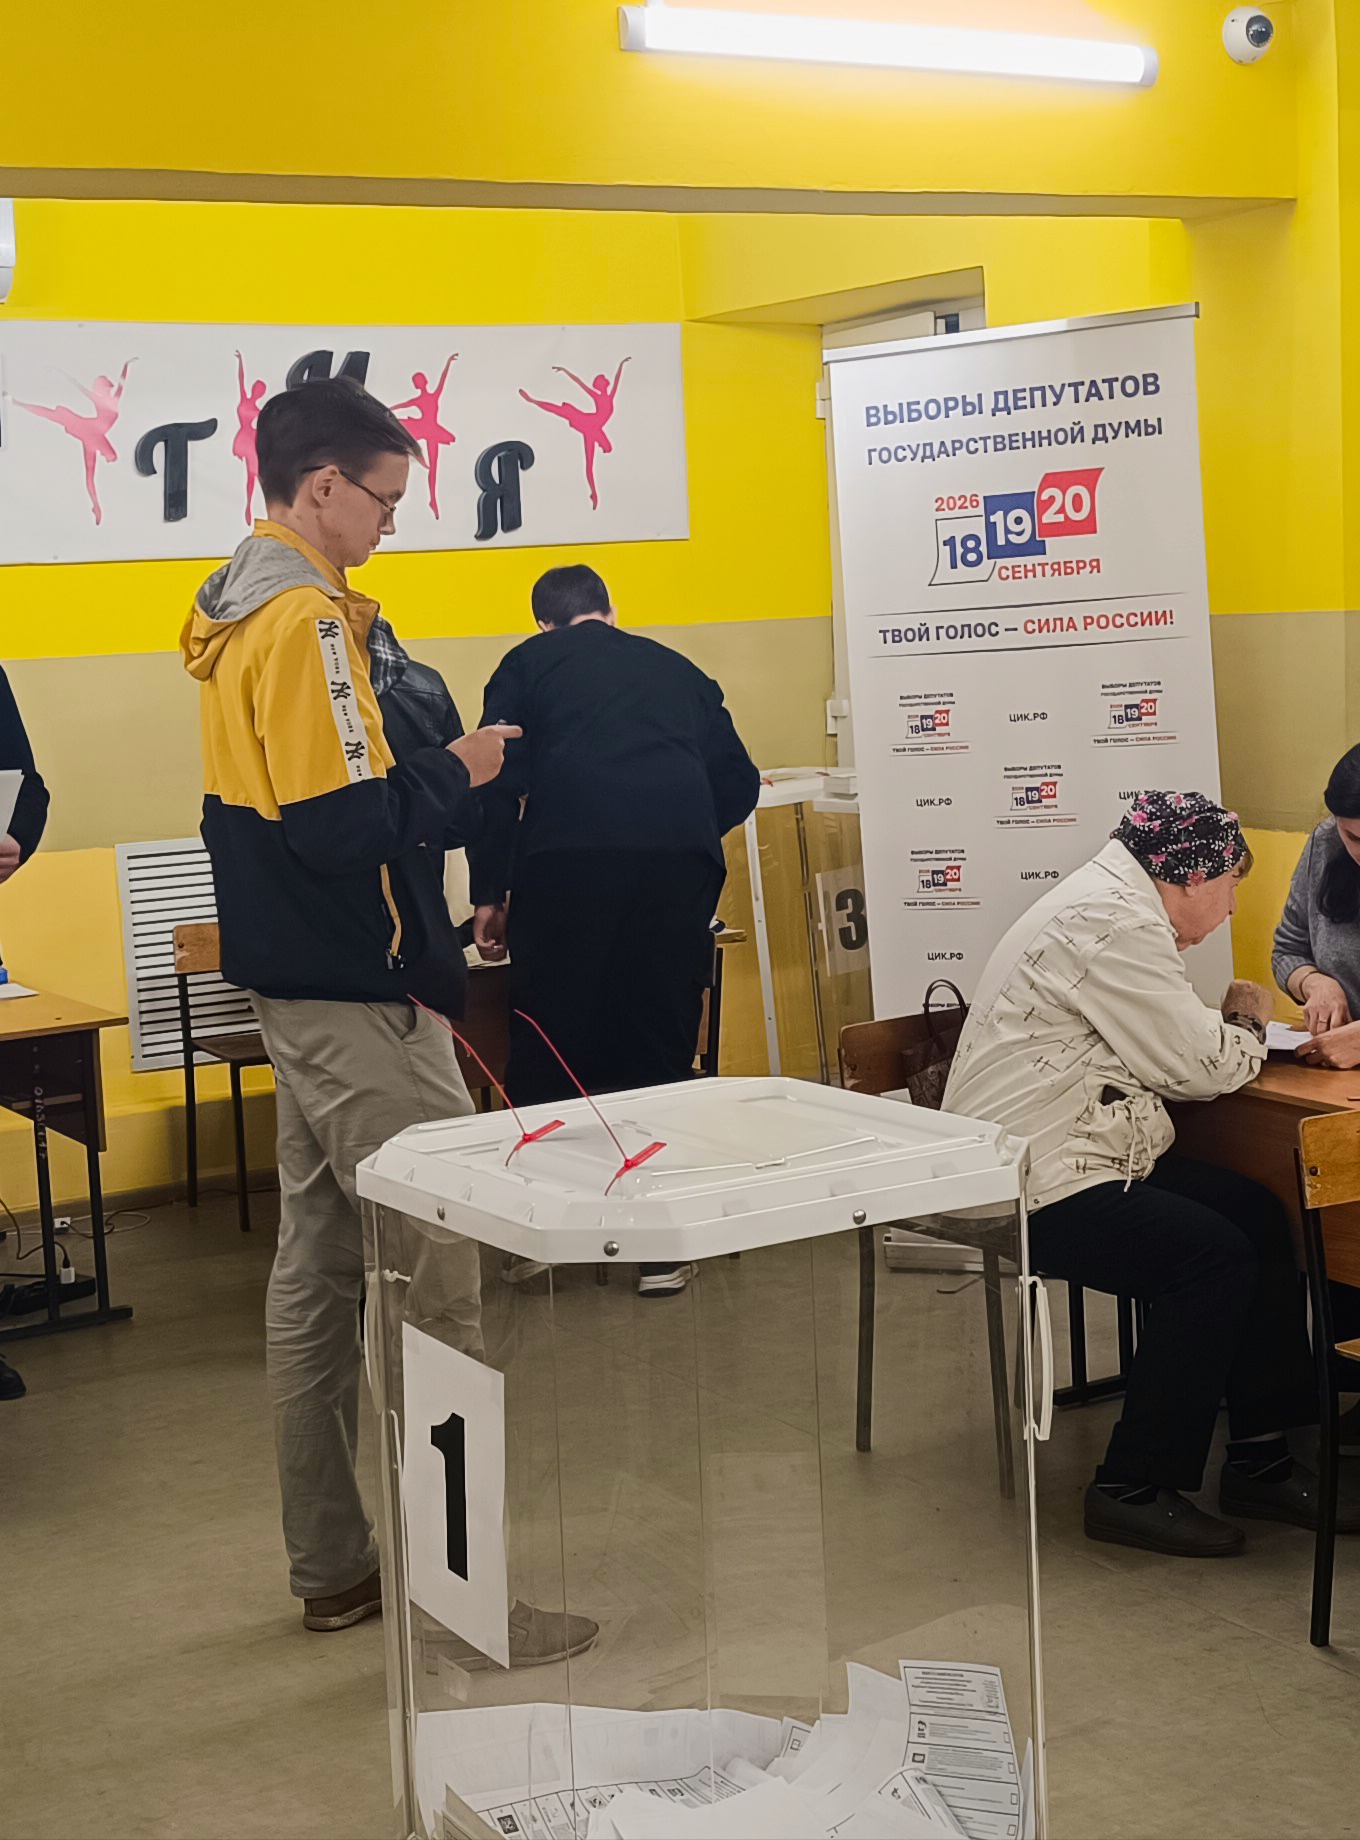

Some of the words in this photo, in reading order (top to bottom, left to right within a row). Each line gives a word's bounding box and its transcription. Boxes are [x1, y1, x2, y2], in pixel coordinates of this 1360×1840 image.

[865, 393, 983, 427] ВЫБОРЫ
[991, 372, 1160, 416] ДЕПУТАТОВ
[867, 420, 1085, 465] ГОСУДАРСТВЕННОЙ
[1091, 417, 1163, 444] ДУМЫ
[935, 493, 980, 512] 2026
[943, 533, 984, 569] 18
[990, 508, 1033, 546] 19
[1041, 485, 1091, 524] 20
[998, 558, 1101, 581] СЕНТЯБРЯ
[879, 623, 931, 644] ТВОЙ
[936, 621, 1000, 642] ГОЛОС
[1023, 617, 1078, 635] СИЛА
[1083, 609, 1174, 631] РОССИИ!
[910, 725, 920, 734] 18
[922, 719, 933, 728] 19
[934, 713, 947, 723] 20
[1009, 711, 1048, 723] ЦИК.РФ
[1112, 715, 1124, 724] 18
[1126, 708, 1138, 718] 19
[1140, 702, 1154, 713] 20
[916, 797, 952, 807] ЦИК.РФ
[1014, 797, 1025, 806] 18
[1027, 791, 1038, 800] 19
[1040, 785, 1055, 795] 20
[921, 880, 931, 888] 18
[934, 874, 944, 883] 19
[946, 869, 959, 879] 20
[1021, 871, 1059, 880] ЦИК.РФ
[836, 888, 868, 950] 3
[927, 952, 964, 961] ЦИК.РФ
[431, 1412, 468, 1581] 1
